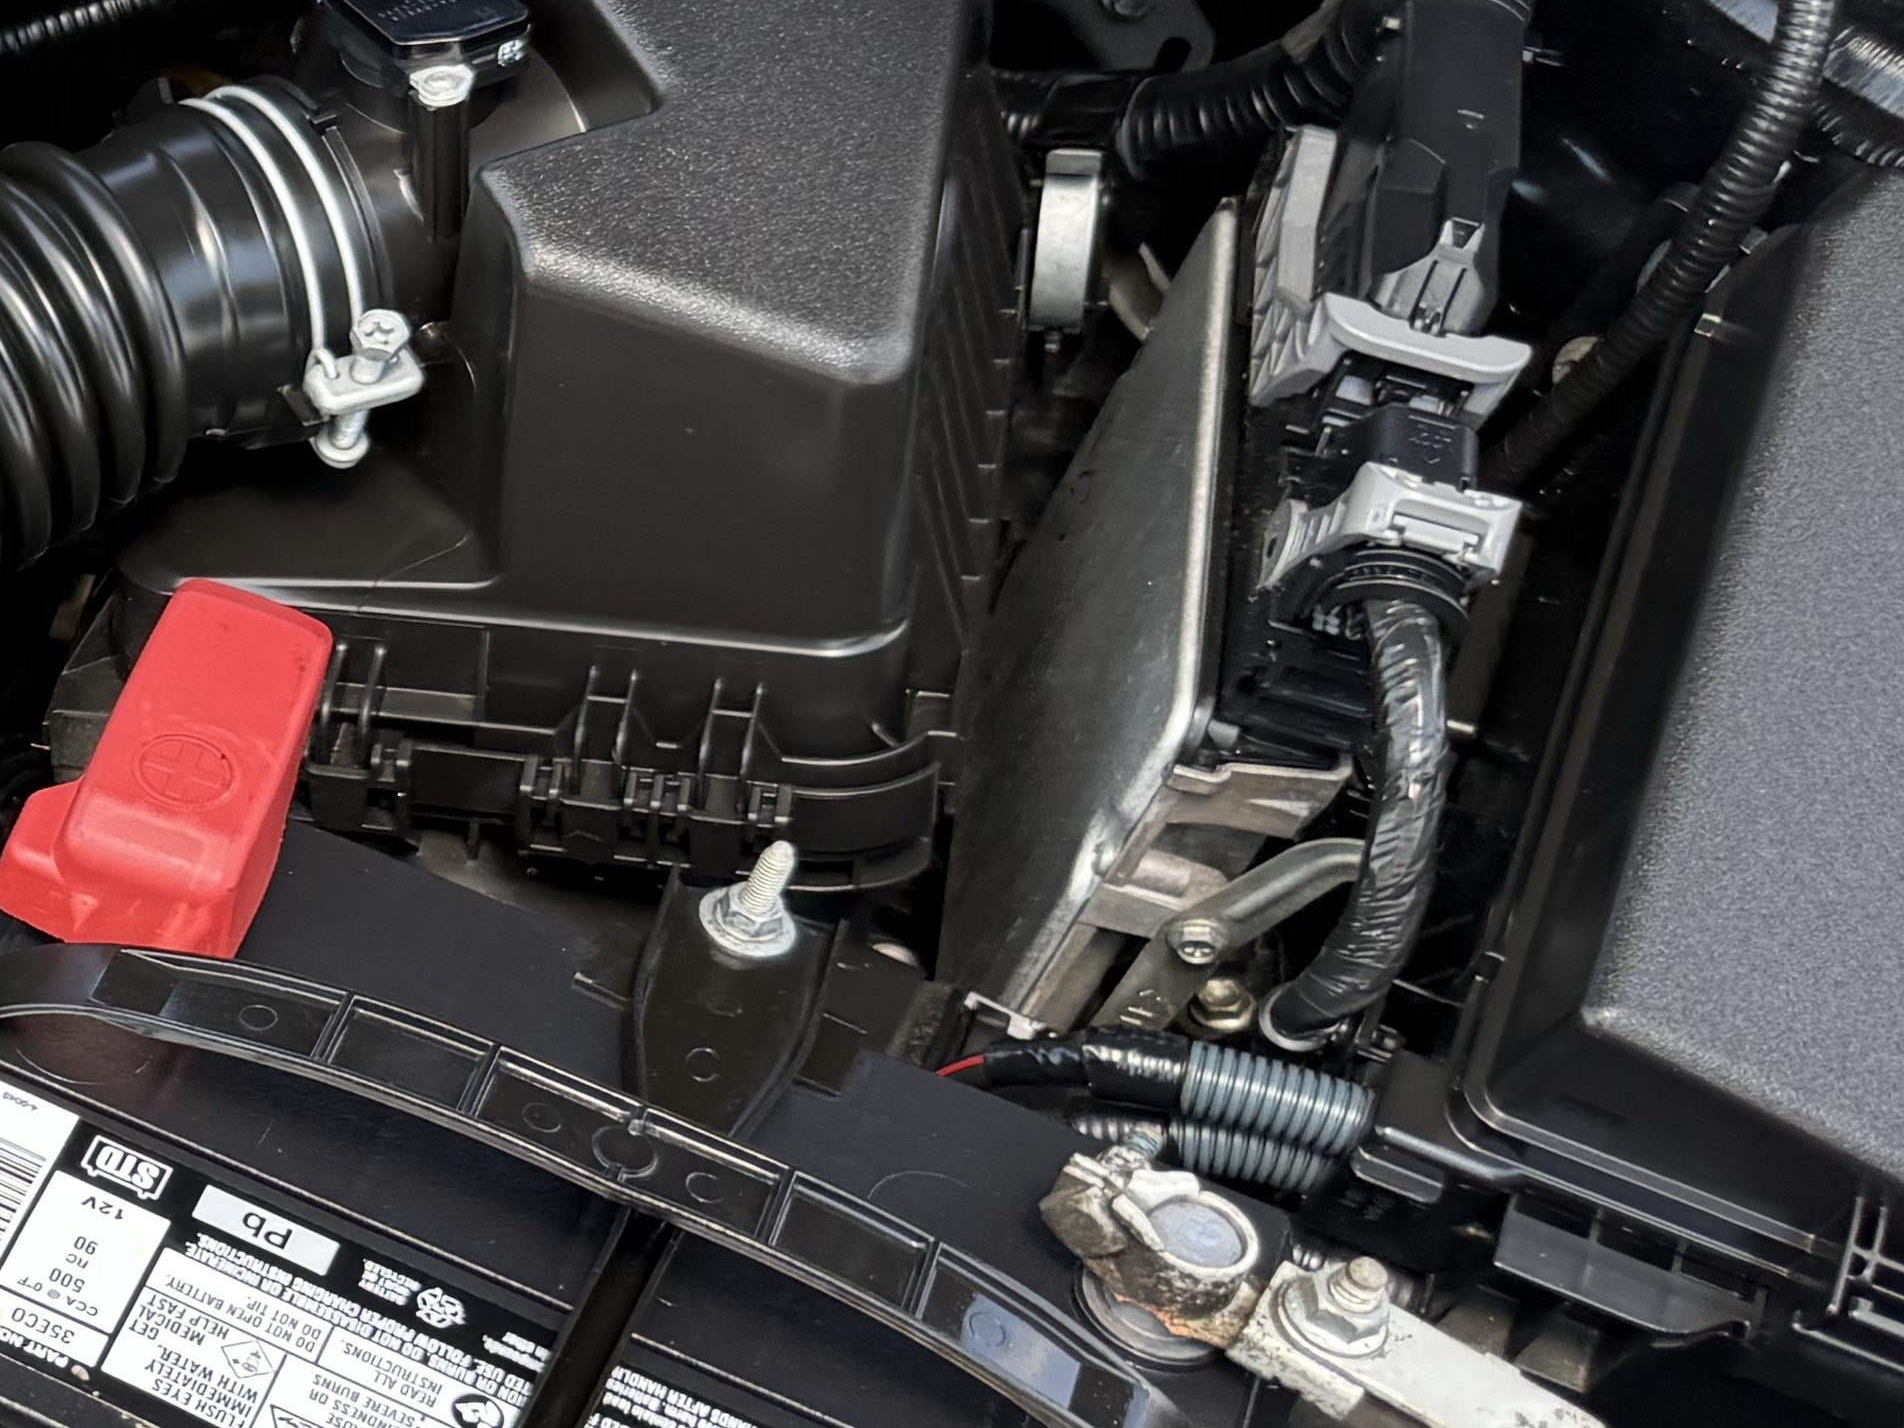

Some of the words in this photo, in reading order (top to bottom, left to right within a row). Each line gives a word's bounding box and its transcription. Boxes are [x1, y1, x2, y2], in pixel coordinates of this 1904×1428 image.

[91, 1142, 163, 1191] STD
[79, 1192, 127, 1222] 12V
[235, 1209, 294, 1250] Pb
[71, 1233, 99, 1256] 90
[63, 1250, 90, 1270] RC
[46, 1265, 87, 1294] 500
[160, 1272, 227, 1311] BATTERY.
[62, 1293, 100, 1317] CCA
[224, 1302, 264, 1328] OPEN
[241, 1295, 270, 1316] TIP.
[269, 1308, 300, 1330] NOT
[126, 1316, 161, 1341] GET
[133, 1303, 208, 1346] MEDICAL
[186, 1311, 231, 1340] HELP
[263, 1321, 294, 1343] NOT
[299, 1322, 323, 1340] DO
[21, 1338, 71, 1369] PART
[293, 1334, 317, 1353] DO
[151, 1343, 217, 1383] WATER.
[335, 1338, 445, 1395] INSTRUCTIONS.
[141, 1356, 255, 1418] IMMEDIATELY
[149, 1376, 194, 1406] EYES
[214, 1373, 260, 1404] WITH
[369, 1368, 399, 1390] ALL
[306, 1387, 330, 1405] OR
[397, 1381, 438, 1409] READ
[360, 1394, 417, 1428] SEVERE
